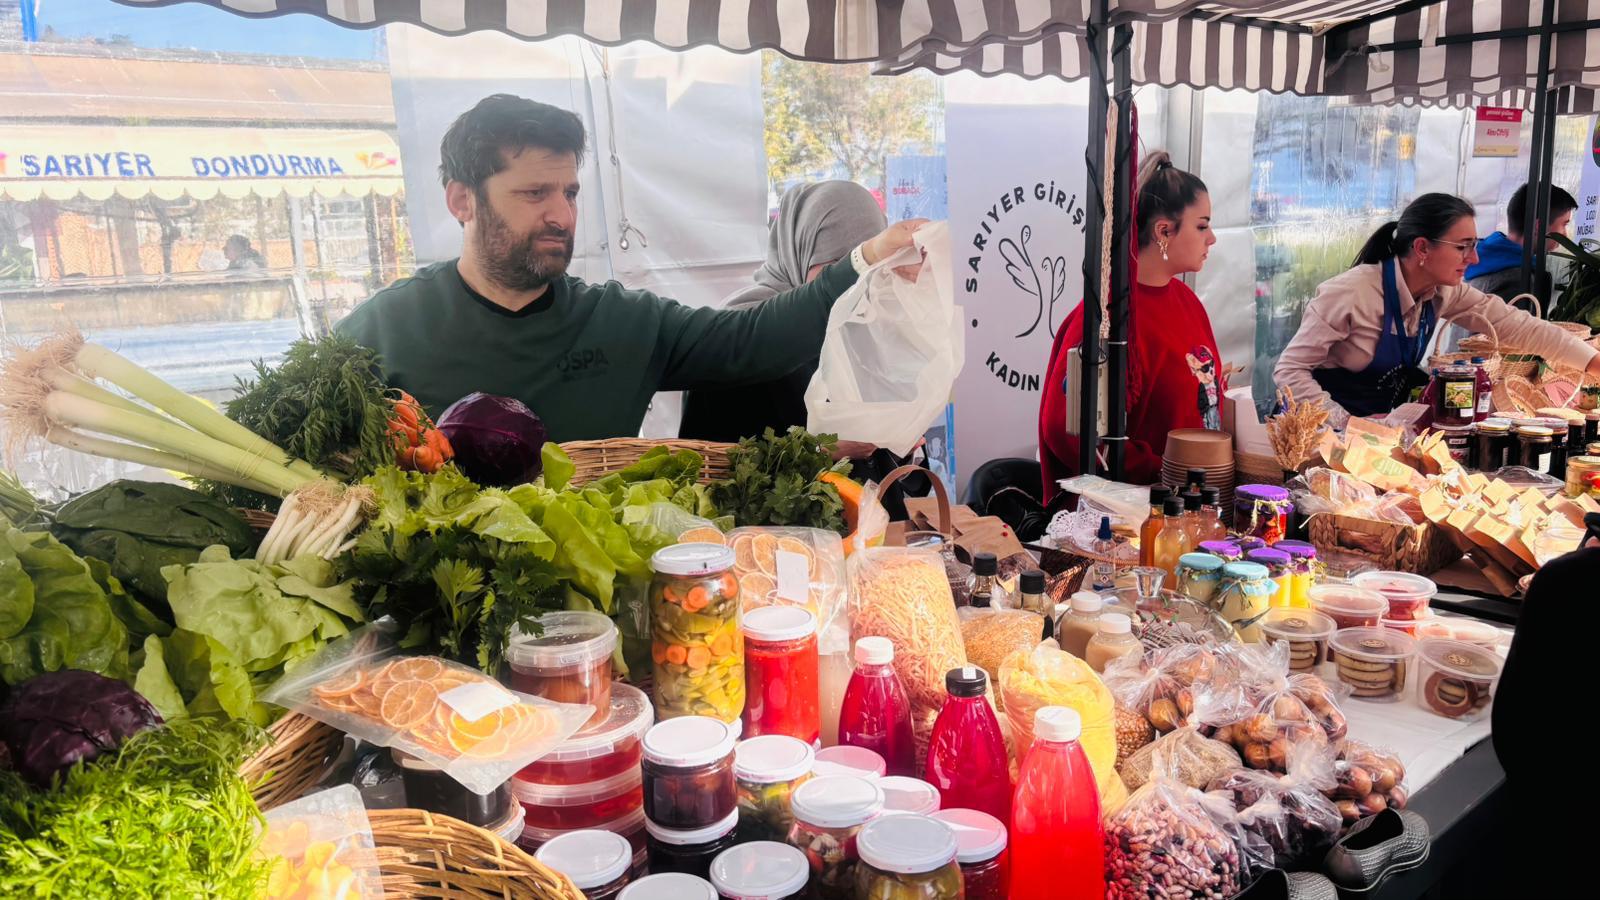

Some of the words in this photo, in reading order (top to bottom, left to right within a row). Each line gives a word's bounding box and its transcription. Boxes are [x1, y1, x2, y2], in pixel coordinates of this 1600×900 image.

[22, 151, 156, 177] SARIYER
[190, 153, 345, 177] DONDURMA
[965, 186, 1025, 293] SARIYER
[985, 351, 1040, 391] KADIN
